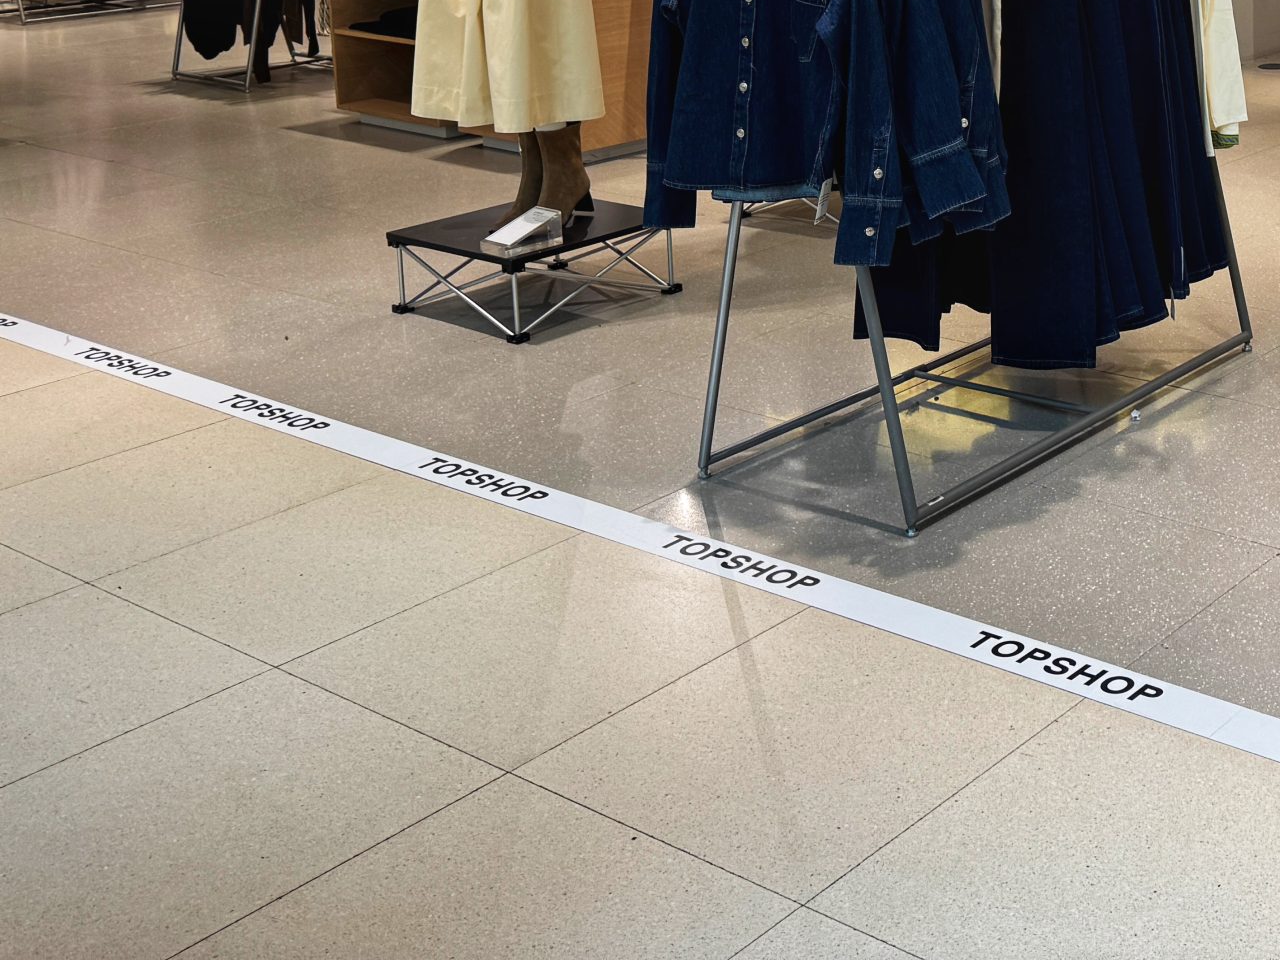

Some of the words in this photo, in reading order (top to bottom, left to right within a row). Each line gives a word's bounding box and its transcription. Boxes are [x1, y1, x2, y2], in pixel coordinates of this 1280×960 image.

[74, 347, 172, 379] TOPSHOP
[218, 394, 331, 431] TOPSHOP
[418, 457, 550, 503] TOPSHOP
[662, 534, 821, 591] TOPSHOP
[968, 630, 1164, 704] TOPSHOP
